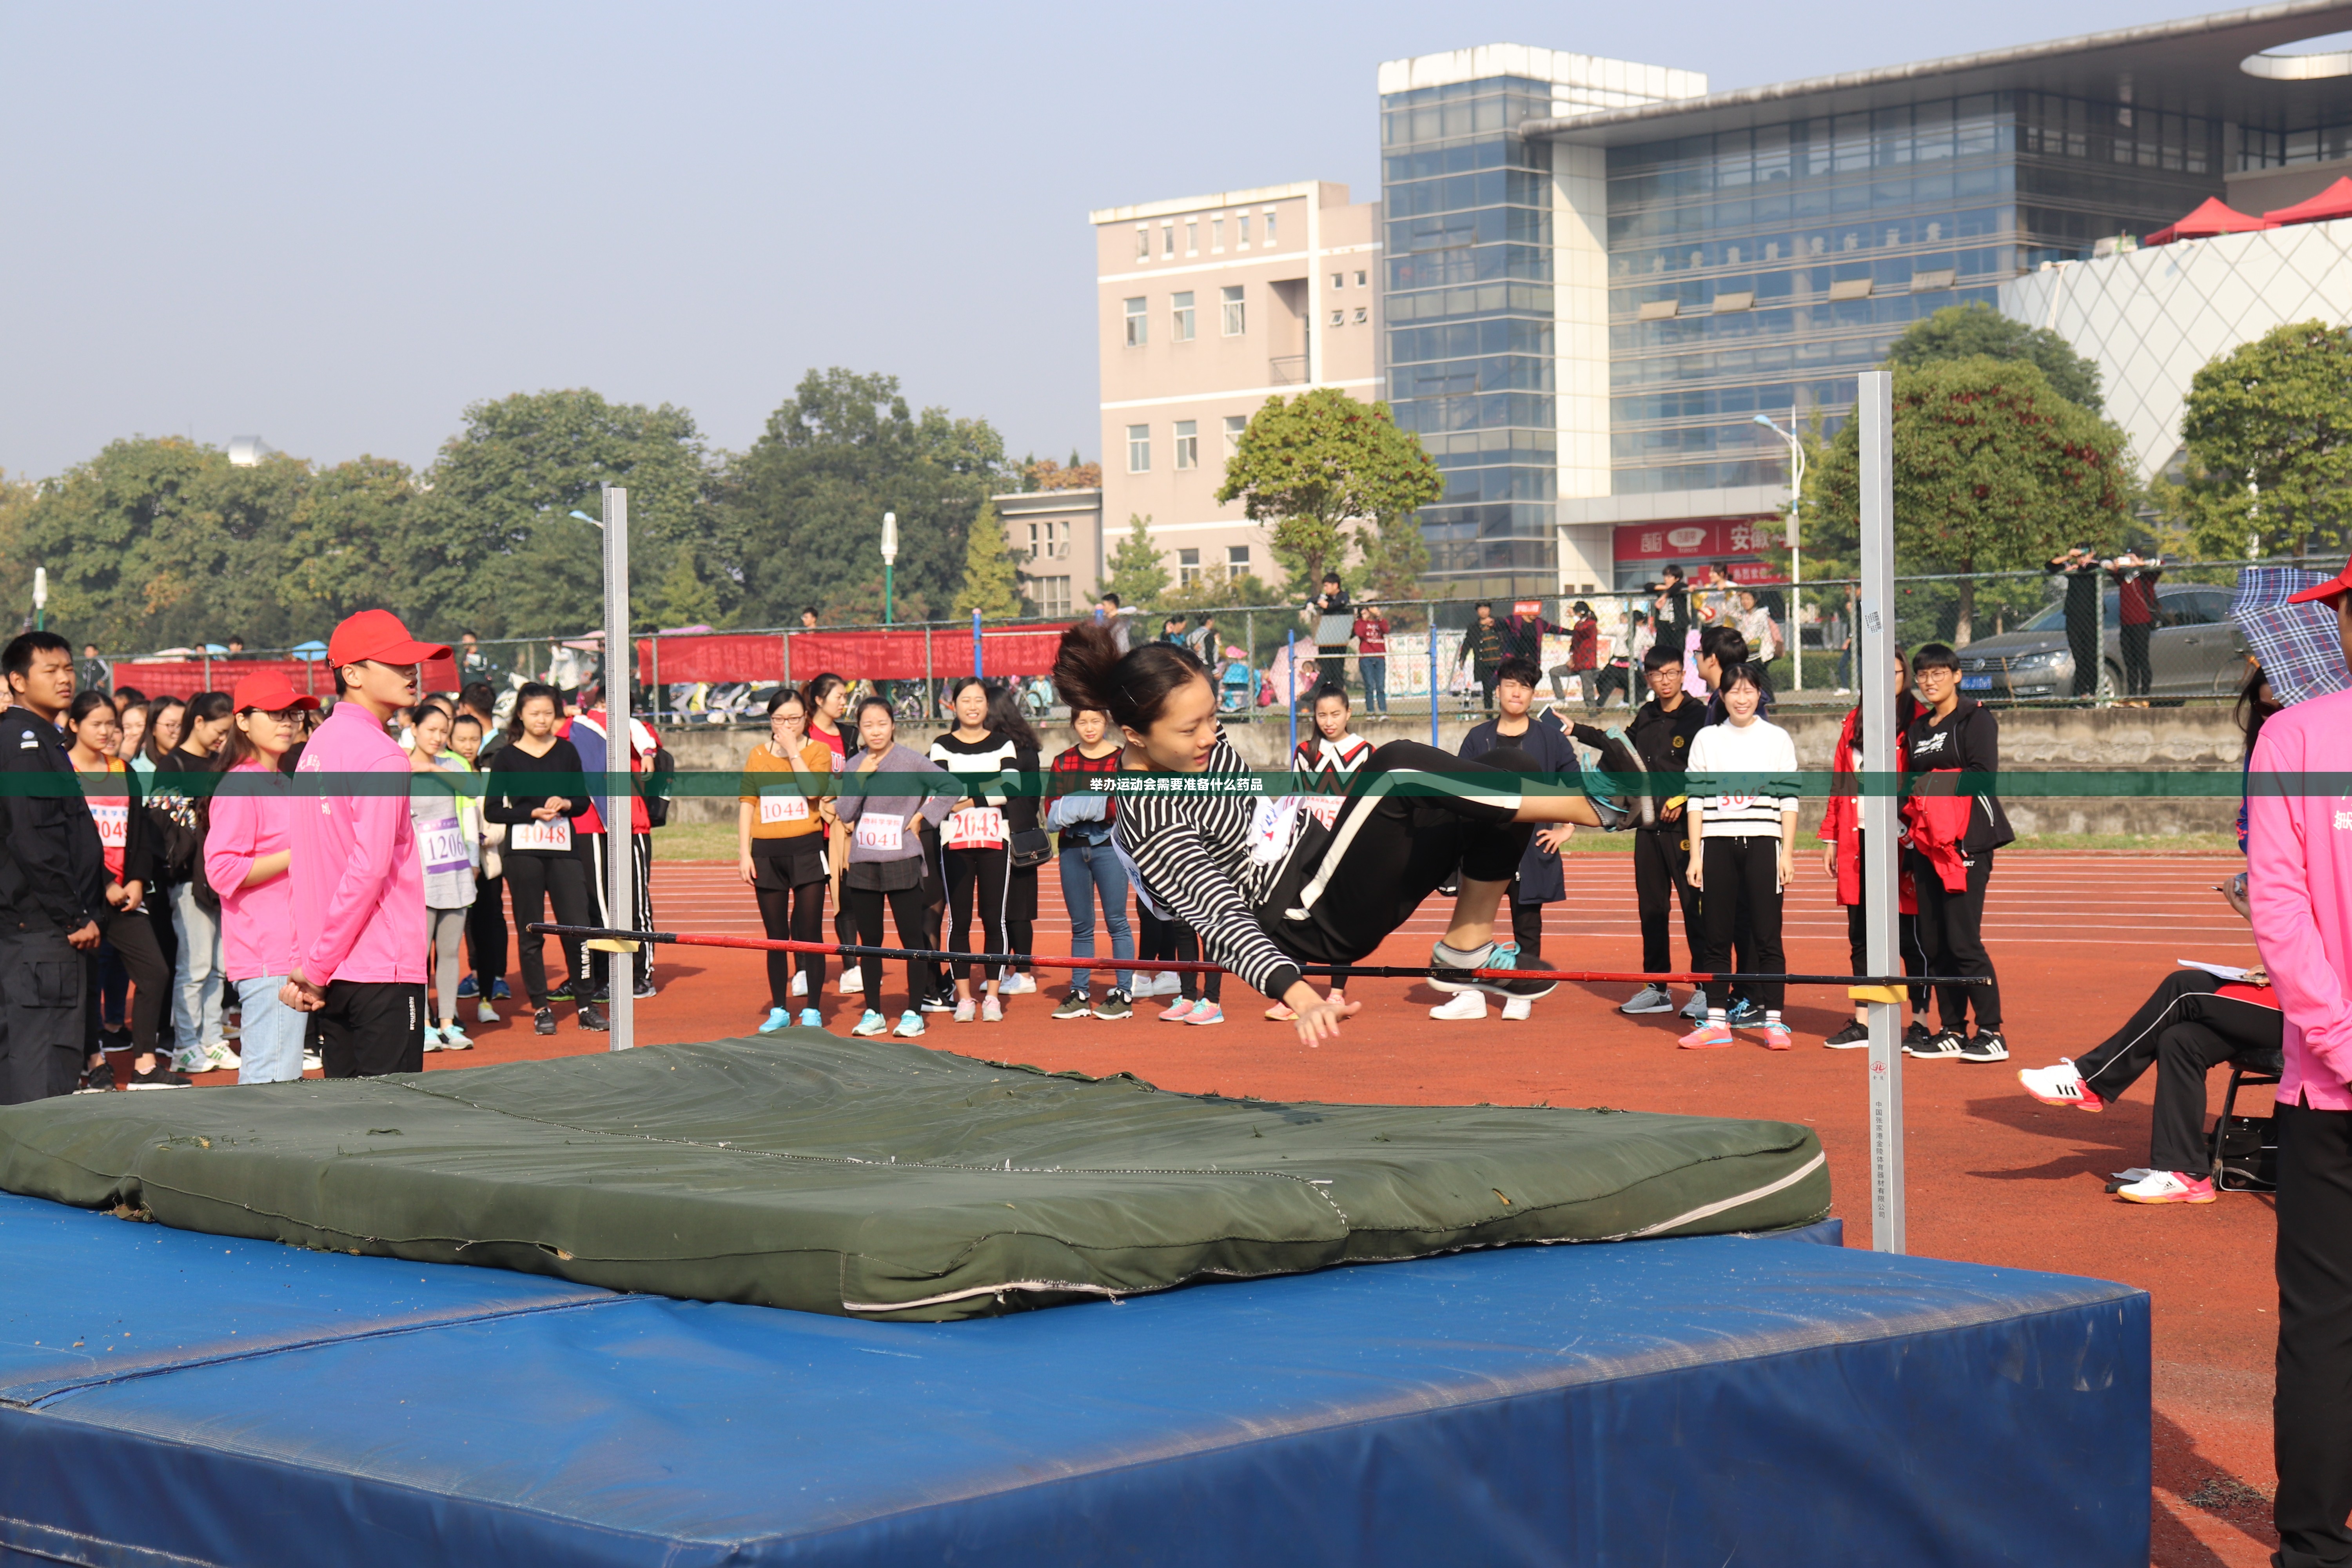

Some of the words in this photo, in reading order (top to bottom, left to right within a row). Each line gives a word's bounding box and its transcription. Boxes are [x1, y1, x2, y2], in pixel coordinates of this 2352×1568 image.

[763, 802, 806, 819] 1044
[520, 824, 566, 844] 4048
[953, 813, 999, 839] 2043
[427, 833, 464, 861] 1206
[858, 831, 898, 846] 1041
[1875, 1101, 1885, 1218] 中国张家港金陵体育器材有限公司
